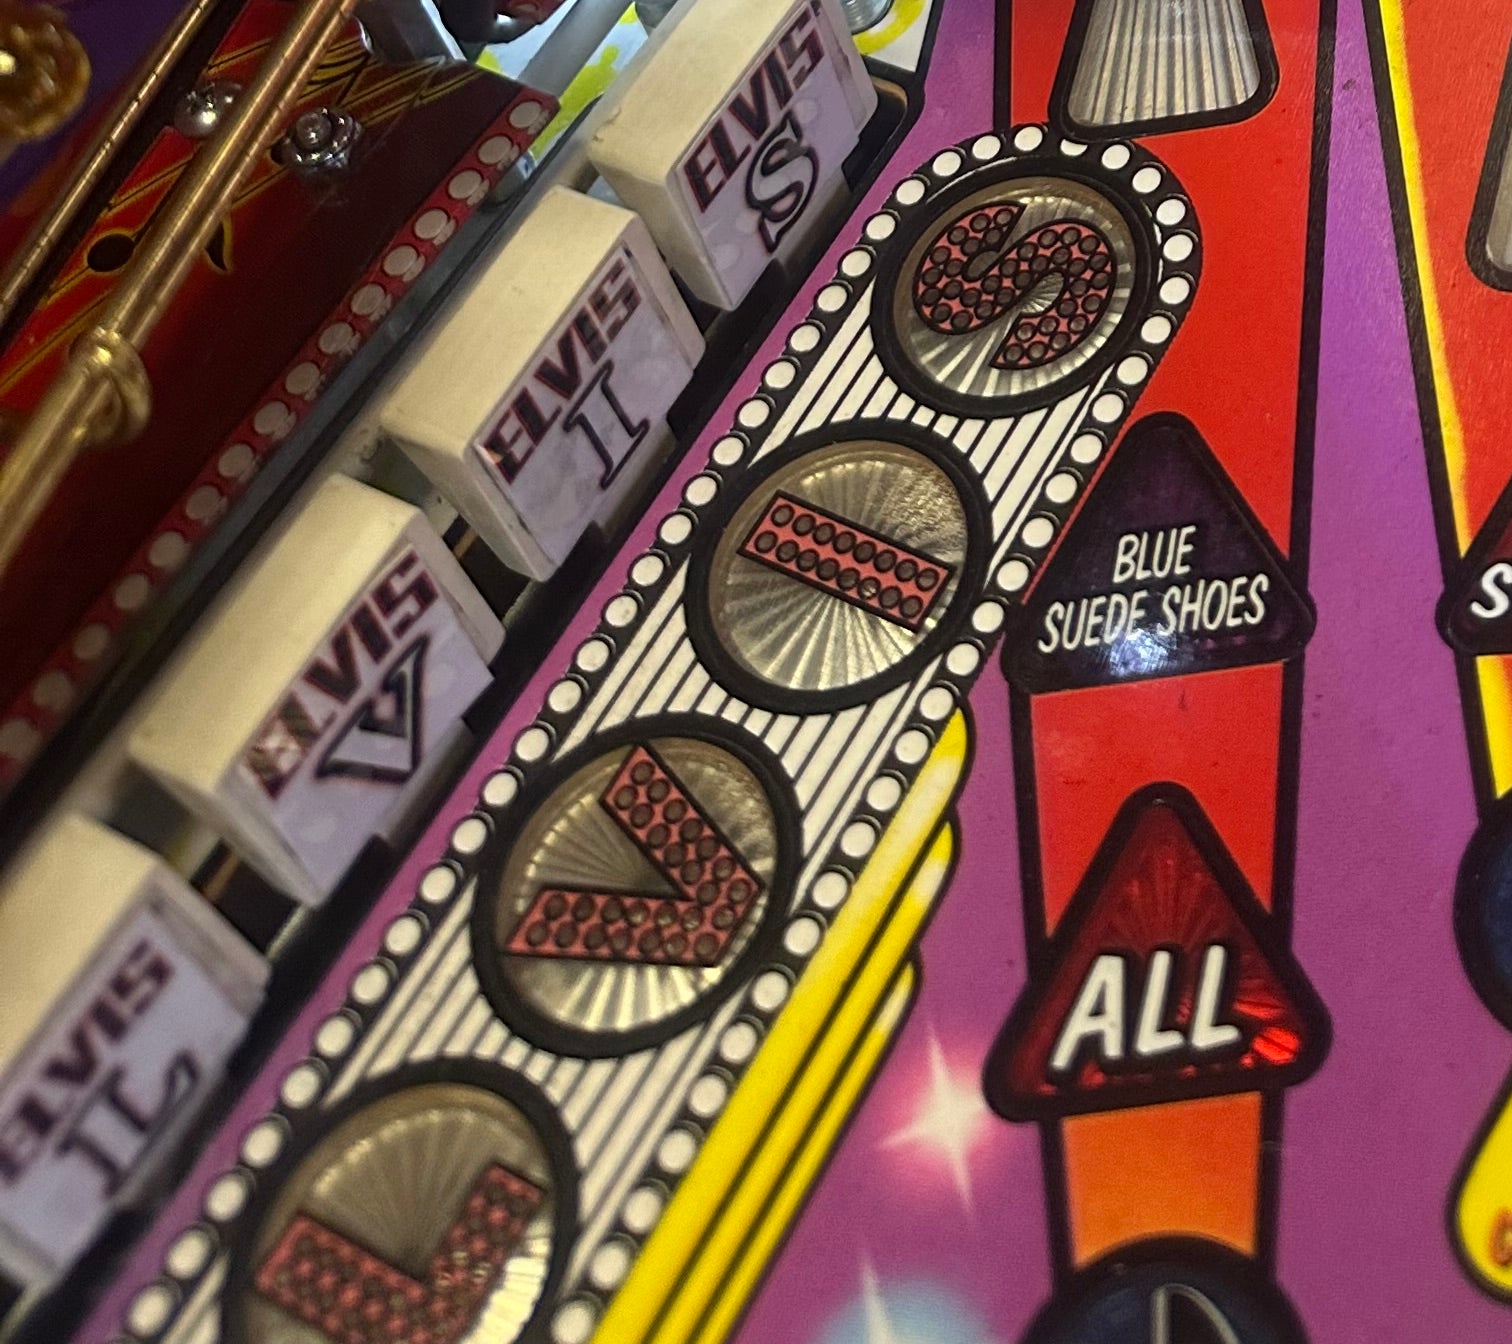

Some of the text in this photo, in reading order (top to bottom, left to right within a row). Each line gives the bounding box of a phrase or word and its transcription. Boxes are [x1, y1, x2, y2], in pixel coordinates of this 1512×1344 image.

[685, 6, 825, 213] ELVIS
[745, 109, 820, 254] S
[480, 260, 645, 484] ELVIS
[1037, 576, 1270, 654] SUEDE SHOES
[1112, 525, 1197, 586] BLUE
[246, 548, 439, 801] ELVIS
[1049, 944, 1244, 1073] ALL
